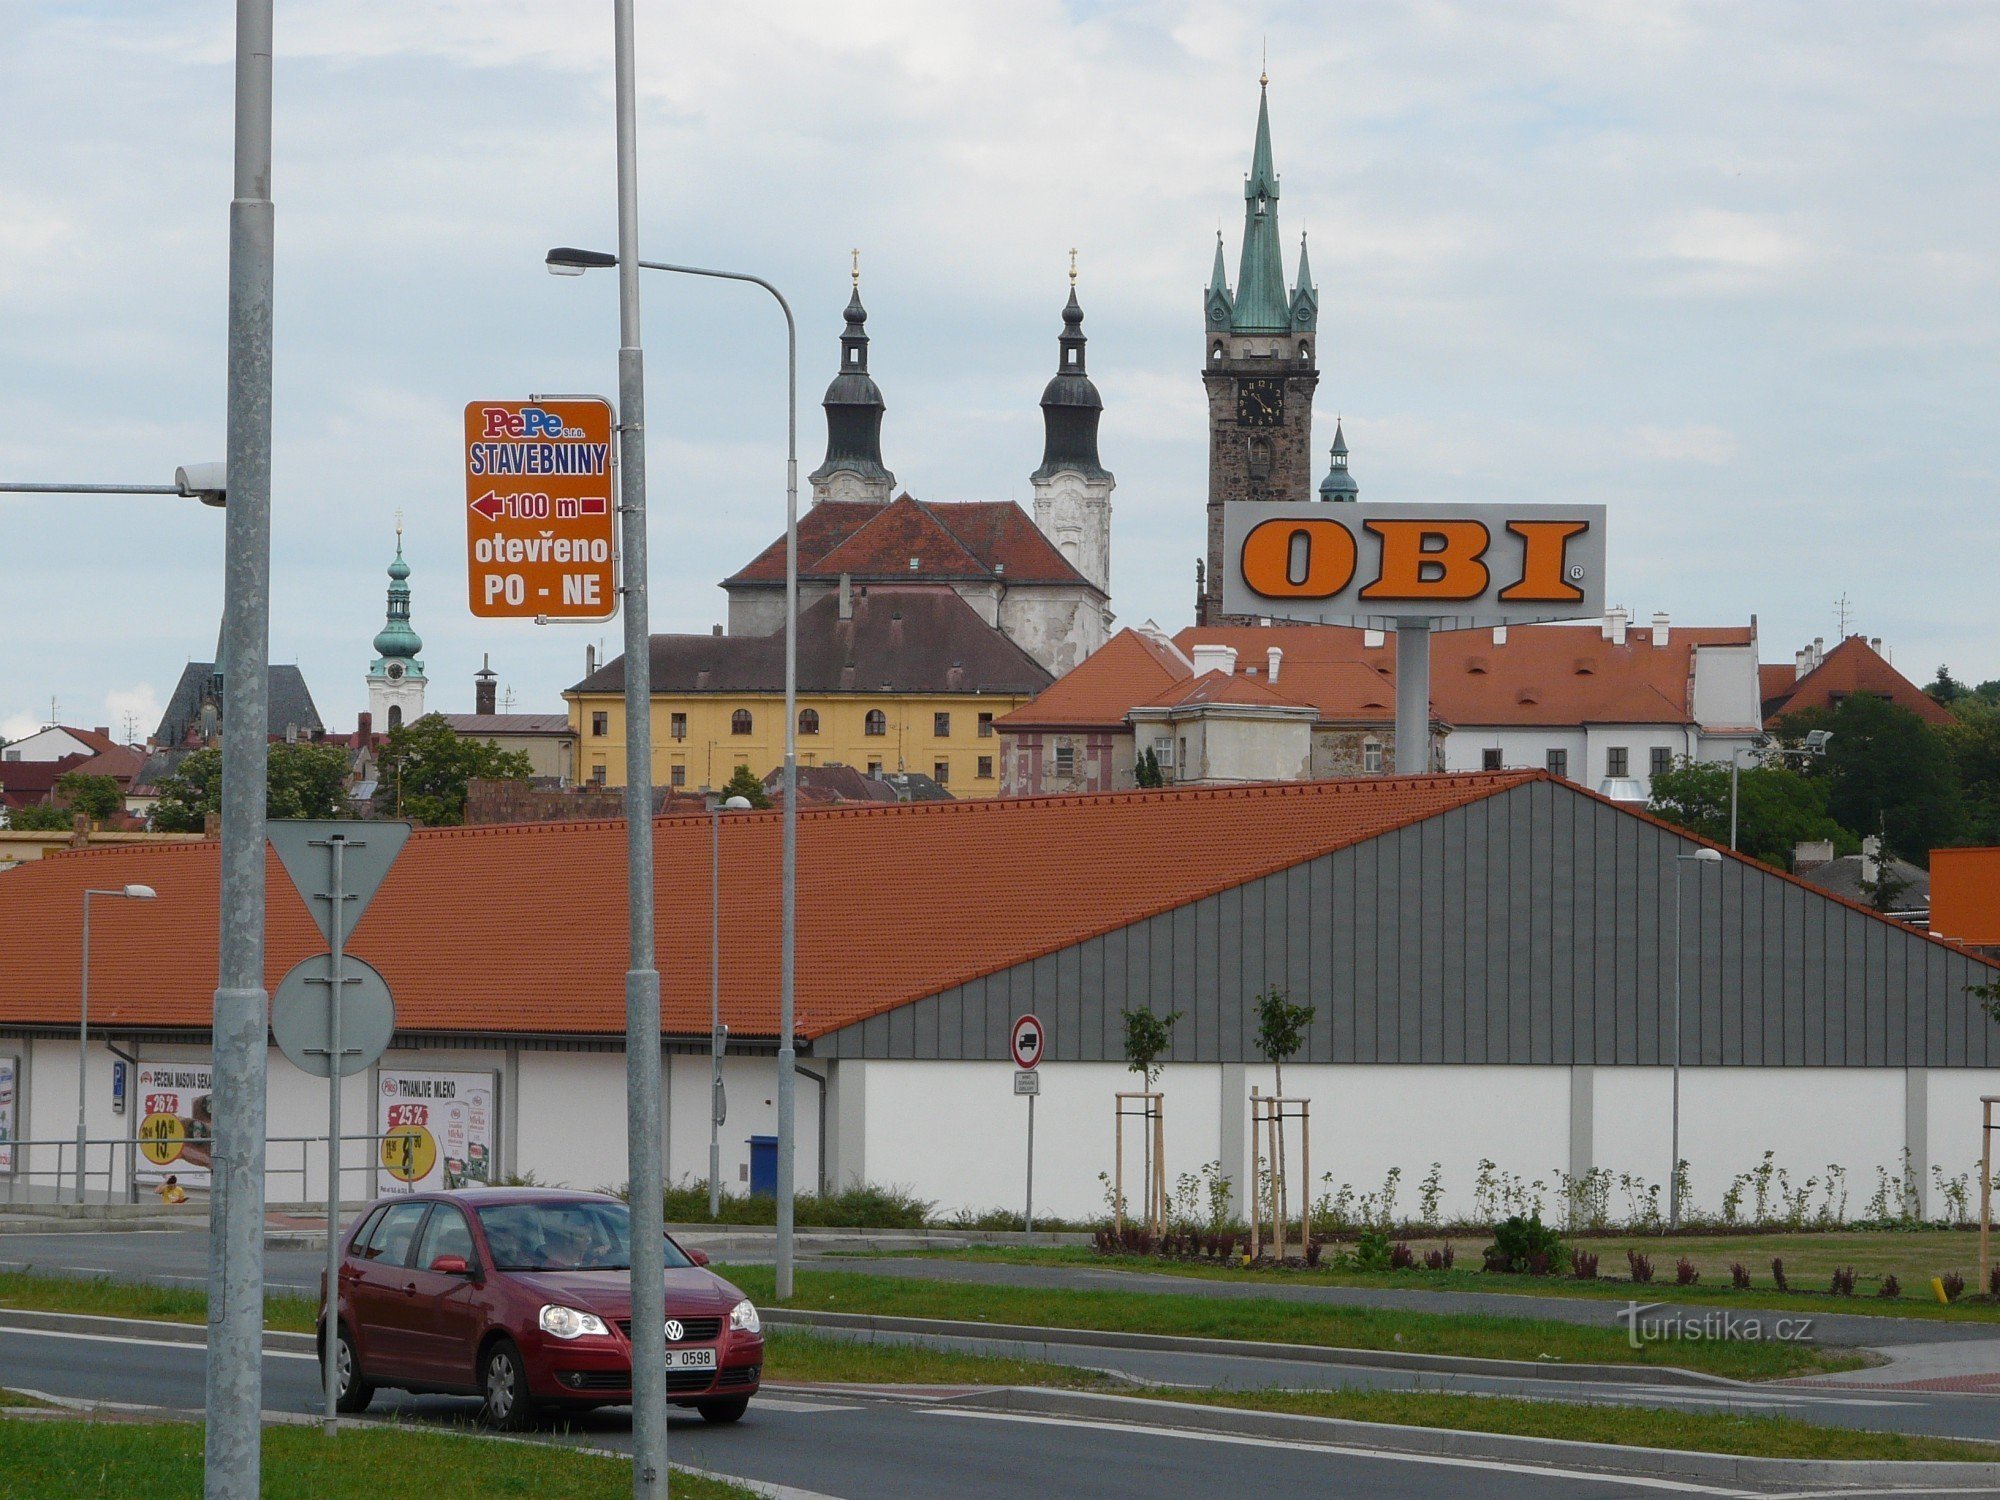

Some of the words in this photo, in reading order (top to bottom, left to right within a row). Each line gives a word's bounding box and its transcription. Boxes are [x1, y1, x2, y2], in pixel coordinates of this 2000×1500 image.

[482, 408, 563, 438] PePe
[563, 428, 585, 438] s.r.o.
[470, 443, 608, 475] STAVEBNINY
[506, 493, 549, 518] 100
[556, 497, 577, 518] m
[475, 530, 608, 563] otevřeno
[1240, 518, 1590, 602] OBI
[484, 574, 524, 605] PO
[538, 588, 549, 596] -
[562, 574, 600, 605] NE
[399, 1077, 431, 1098] TRVANLIVÉ
[434, 1077, 456, 1099] MLÉKO
[682, 1351, 710, 1365] 0598
